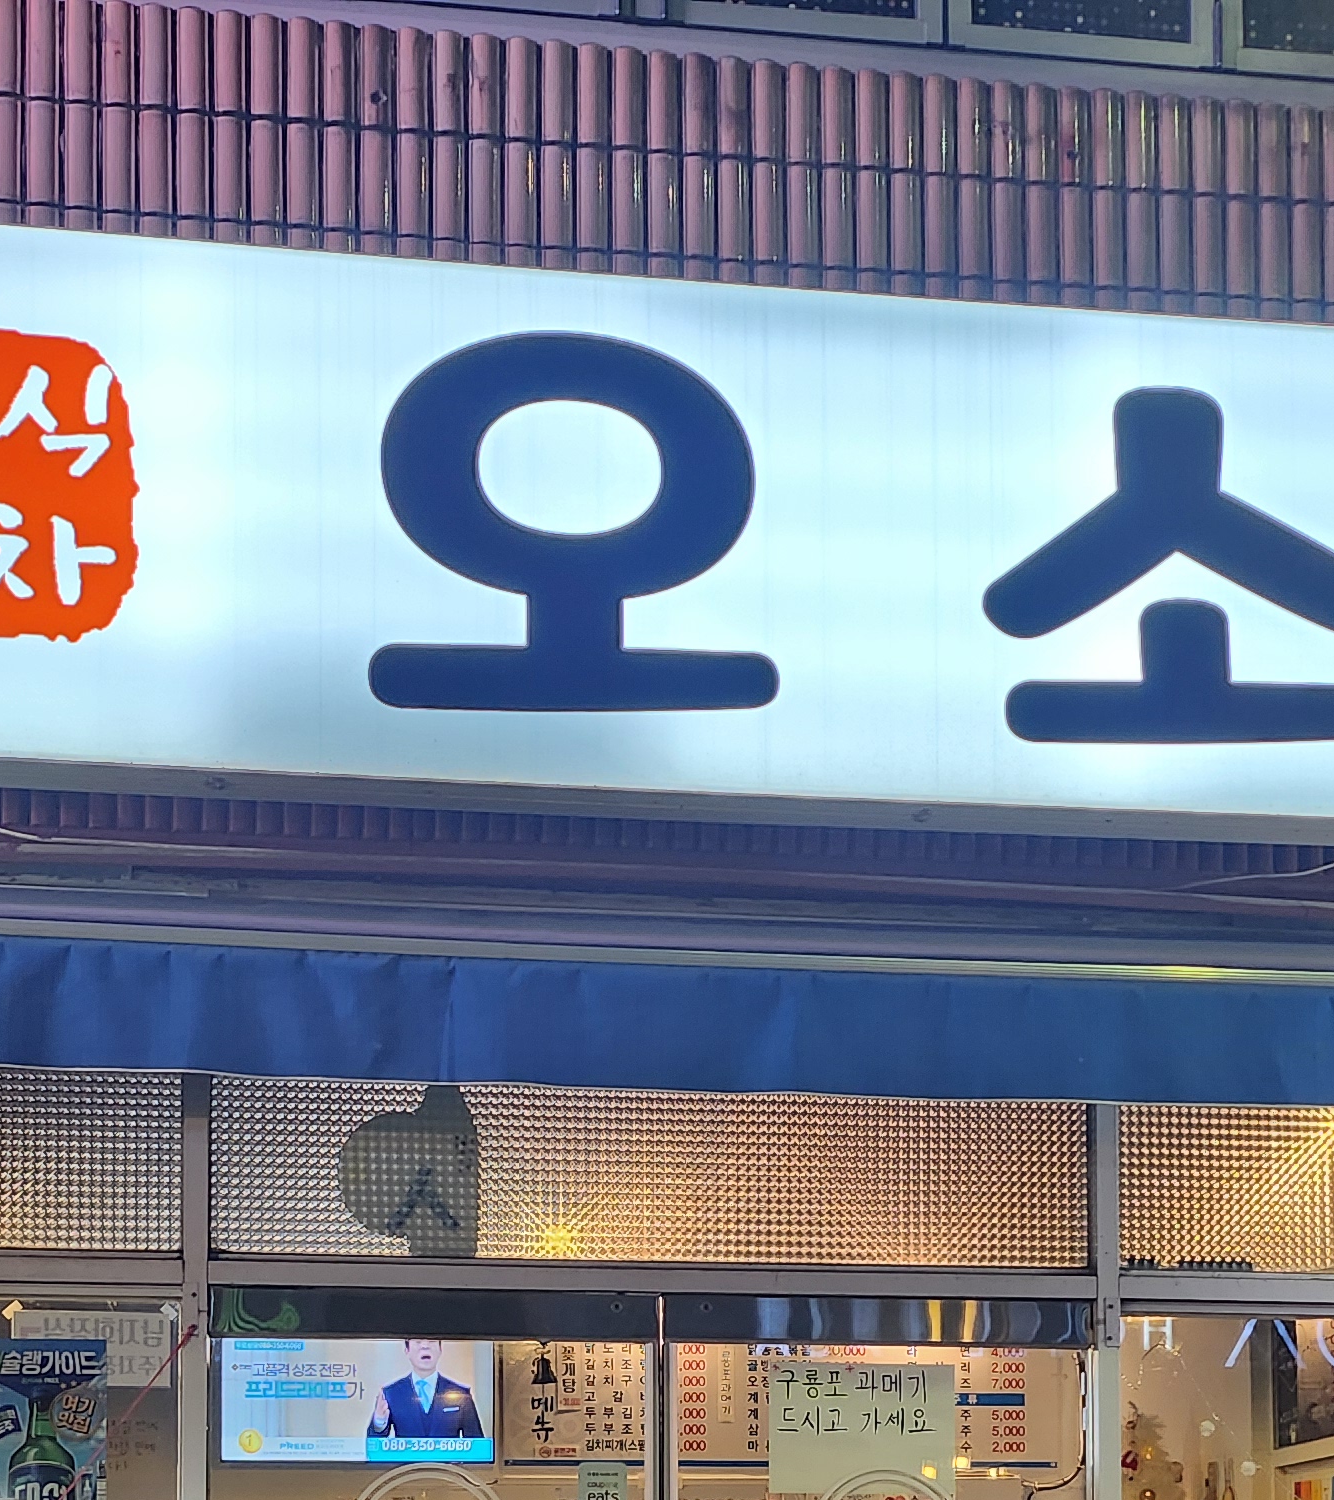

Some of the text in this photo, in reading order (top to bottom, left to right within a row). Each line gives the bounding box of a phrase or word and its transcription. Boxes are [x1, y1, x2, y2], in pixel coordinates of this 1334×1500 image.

[252, 1363, 290, 1377] 고품격
[292, 1363, 317, 1377] 상조
[319, 1363, 357, 1378] 전문가
[991, 1361, 1025, 1374] 2,000
[775, 1368, 928, 1404] 구룡포 과메기
[991, 1377, 1025, 1390] 7,000
[61, 1395, 97, 1416] 여기
[57, 1411, 91, 1434] 맛집
[531, 1395, 555, 1443] 메뉴
[776, 1405, 938, 1437] 드시고 가세요
[991, 1409, 1025, 1422] 5,000
[991, 1425, 1025, 1438] 5,000
[382, 1439, 472, 1452] 080-350-6060
[991, 1441, 1025, 1454] 2,000
